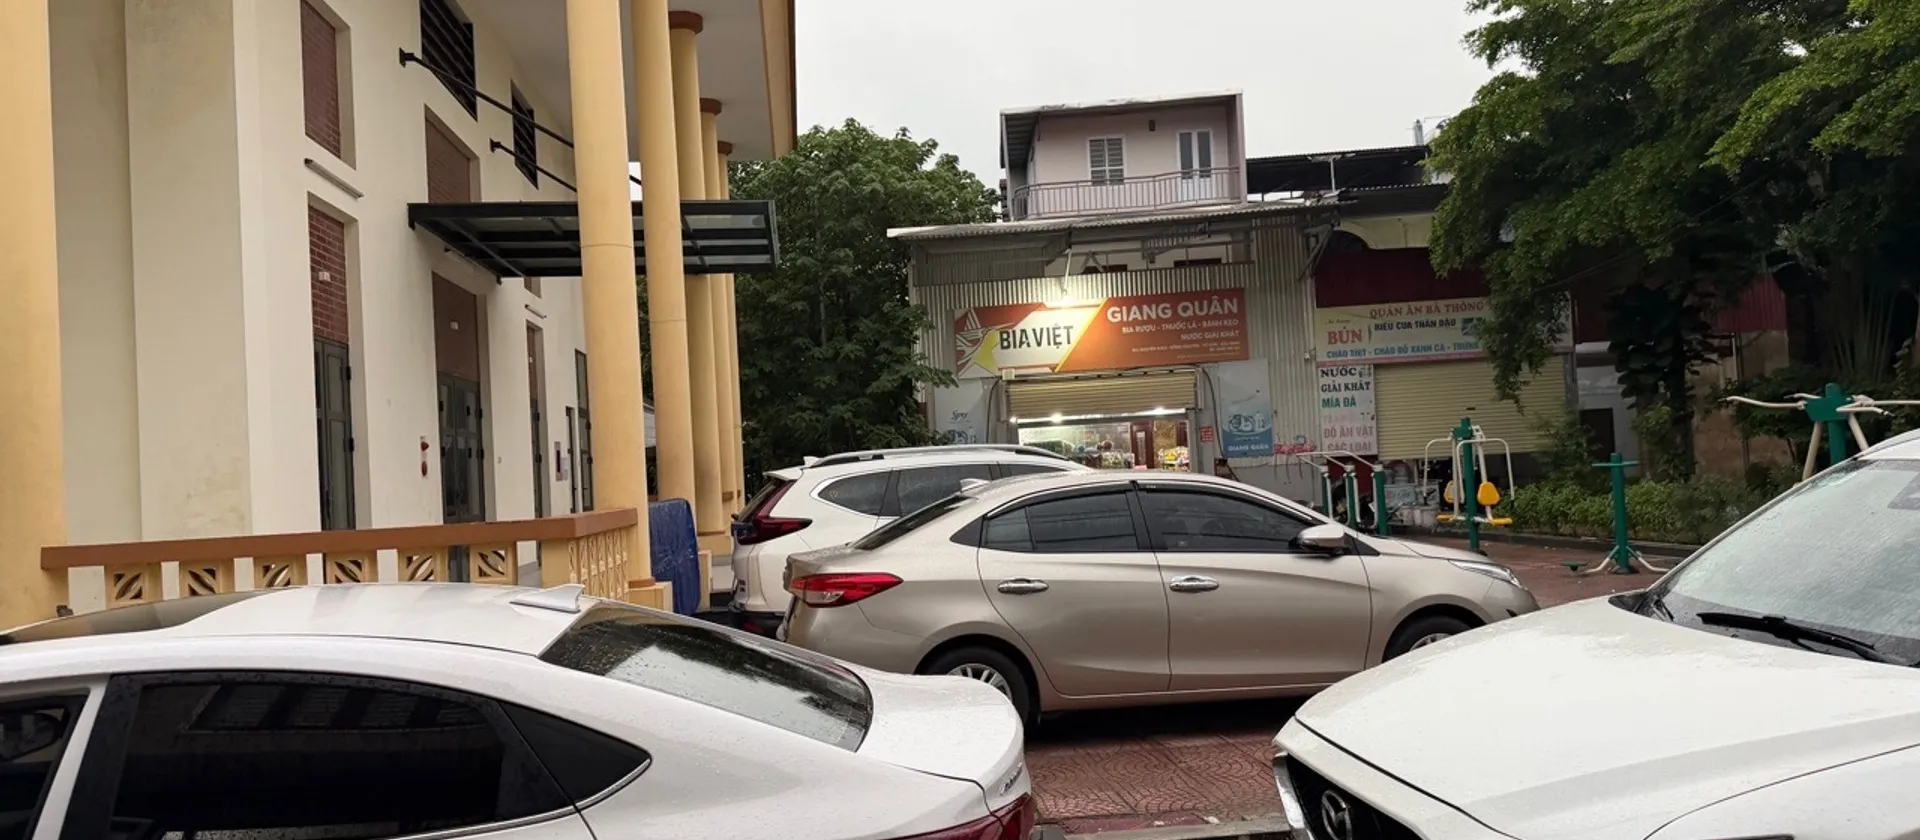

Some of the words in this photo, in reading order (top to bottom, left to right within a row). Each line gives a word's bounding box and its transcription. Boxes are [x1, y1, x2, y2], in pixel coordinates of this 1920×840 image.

[1107, 303, 1172, 323] GIANG
[1177, 295, 1238, 317] QUÂN
[1321, 380, 1342, 393] GIẢI
[1344, 379, 1371, 392] KHÁT
[1321, 396, 1341, 408] MÍA
